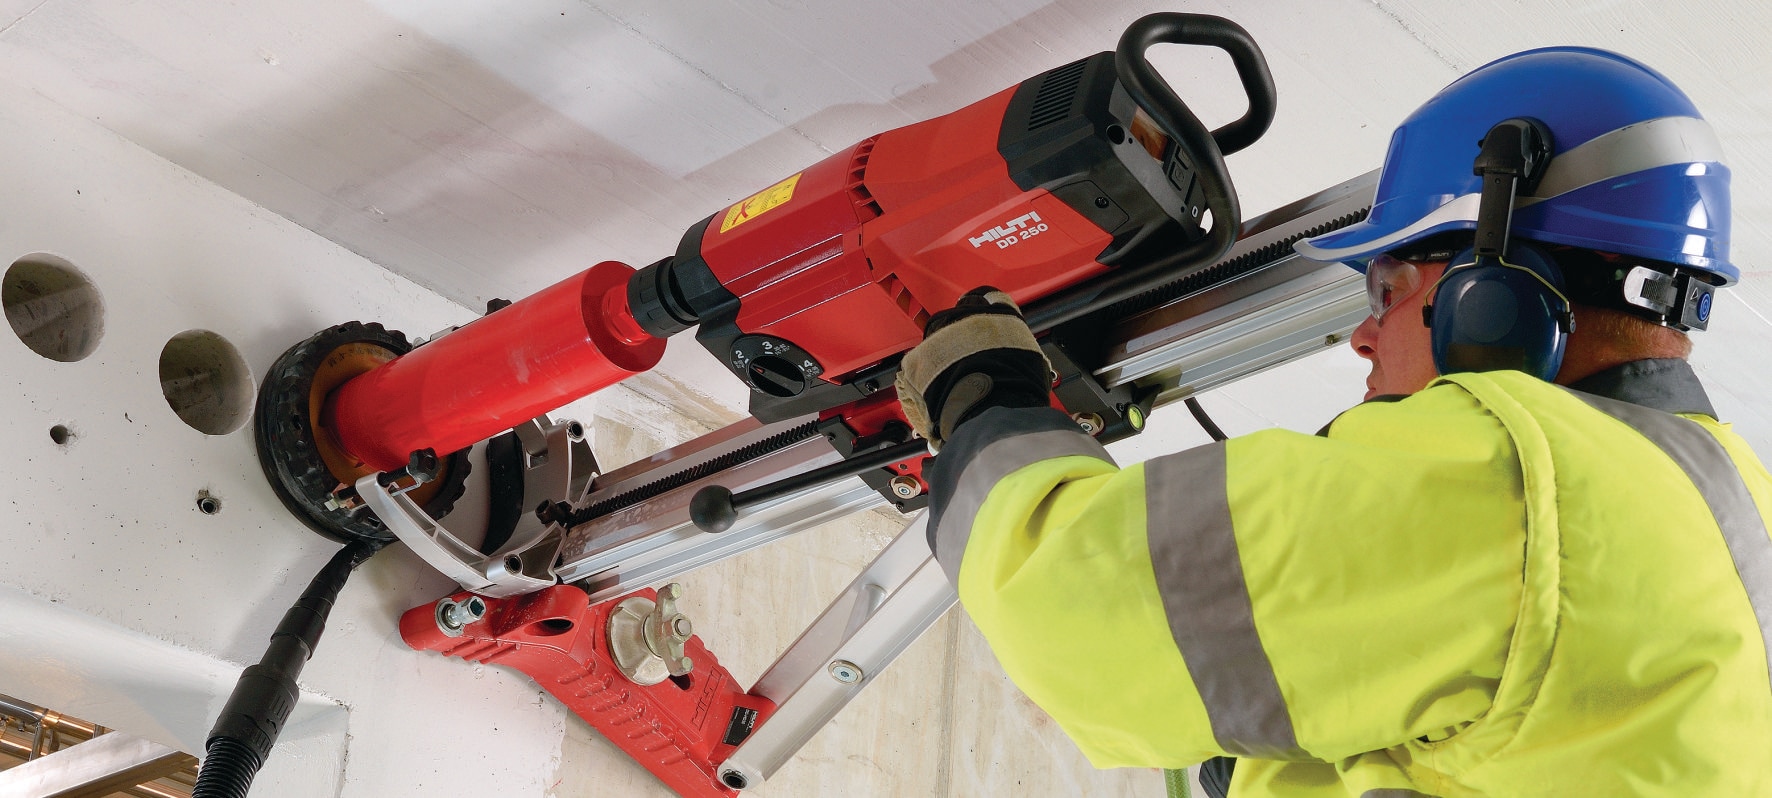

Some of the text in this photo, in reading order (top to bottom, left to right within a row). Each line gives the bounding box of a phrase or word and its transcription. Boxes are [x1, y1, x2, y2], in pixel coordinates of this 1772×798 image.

[968, 210, 1041, 248] HILTI
[996, 223, 1049, 249] DD 250
[762, 341, 773, 350] 3
[735, 350, 744, 359] 2
[804, 359, 813, 367] 4
